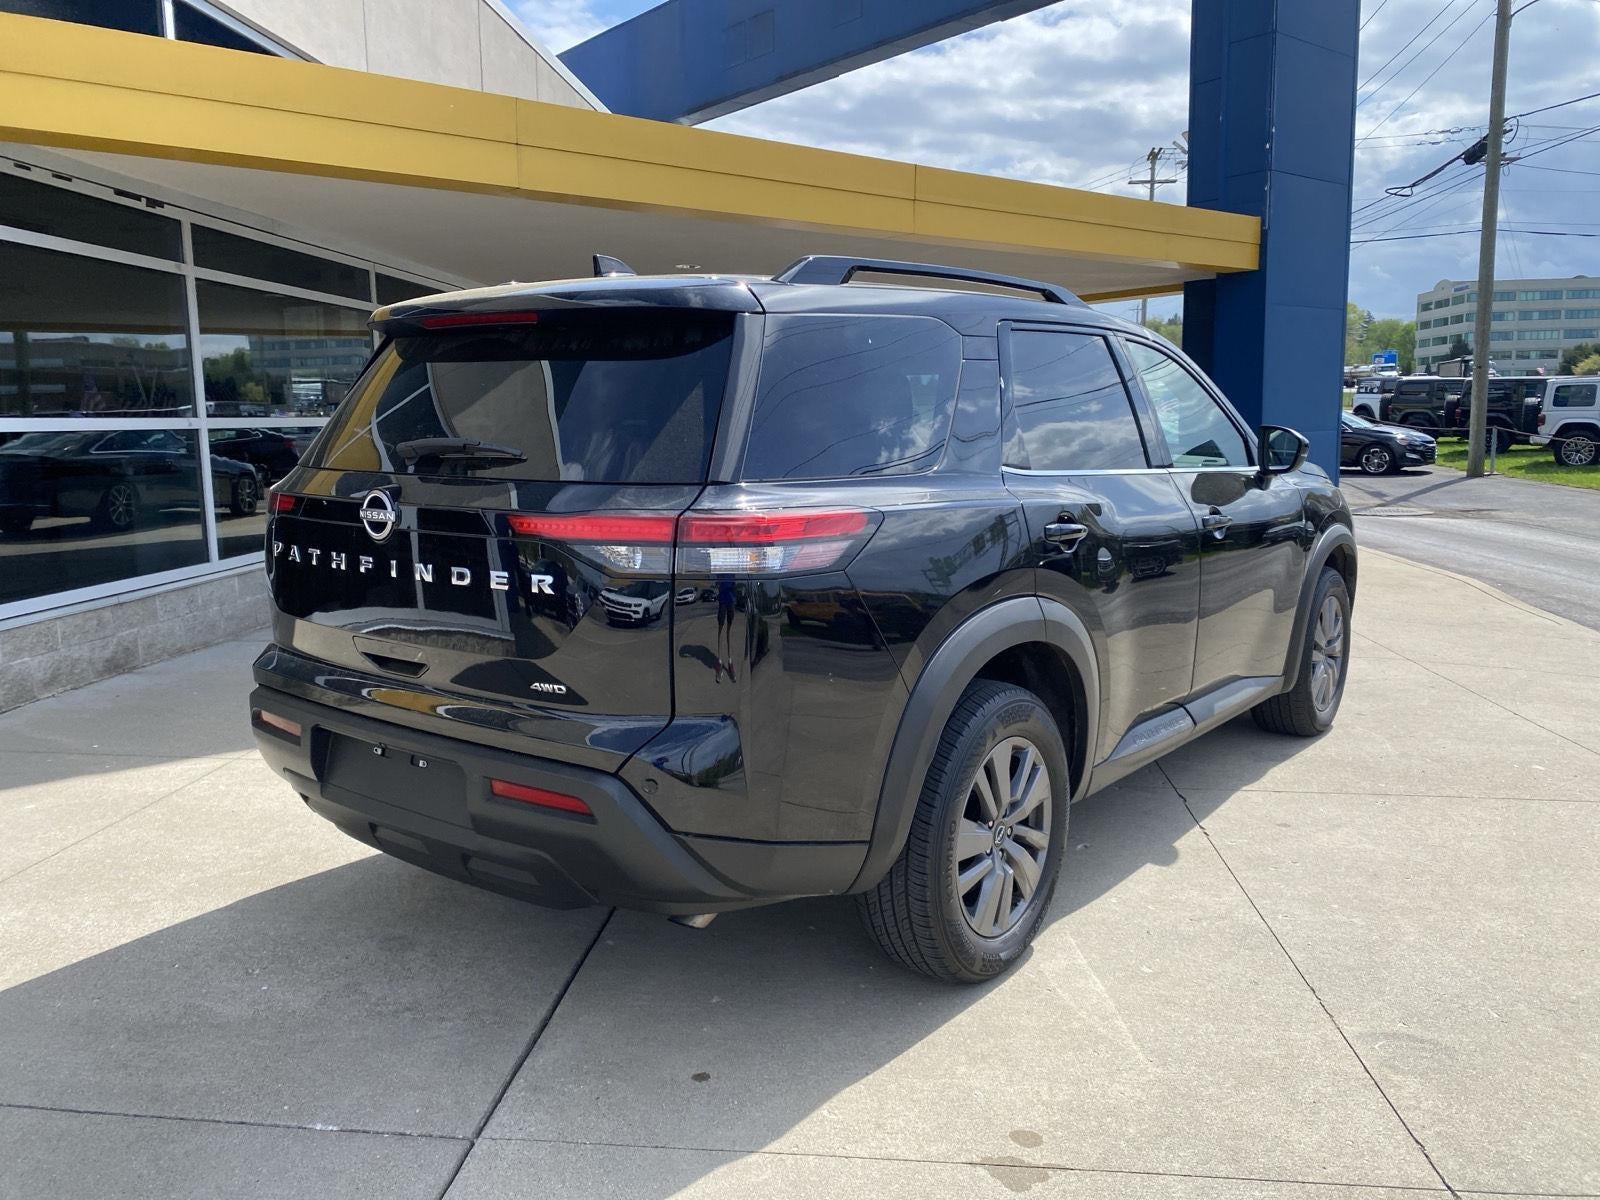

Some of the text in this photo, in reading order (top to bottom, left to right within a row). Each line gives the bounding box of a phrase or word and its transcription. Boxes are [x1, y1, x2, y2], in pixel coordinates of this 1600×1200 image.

[360, 510, 394, 521] NISSAN
[272, 541, 554, 595] PATHFINDER
[529, 682, 567, 695] 4WD
